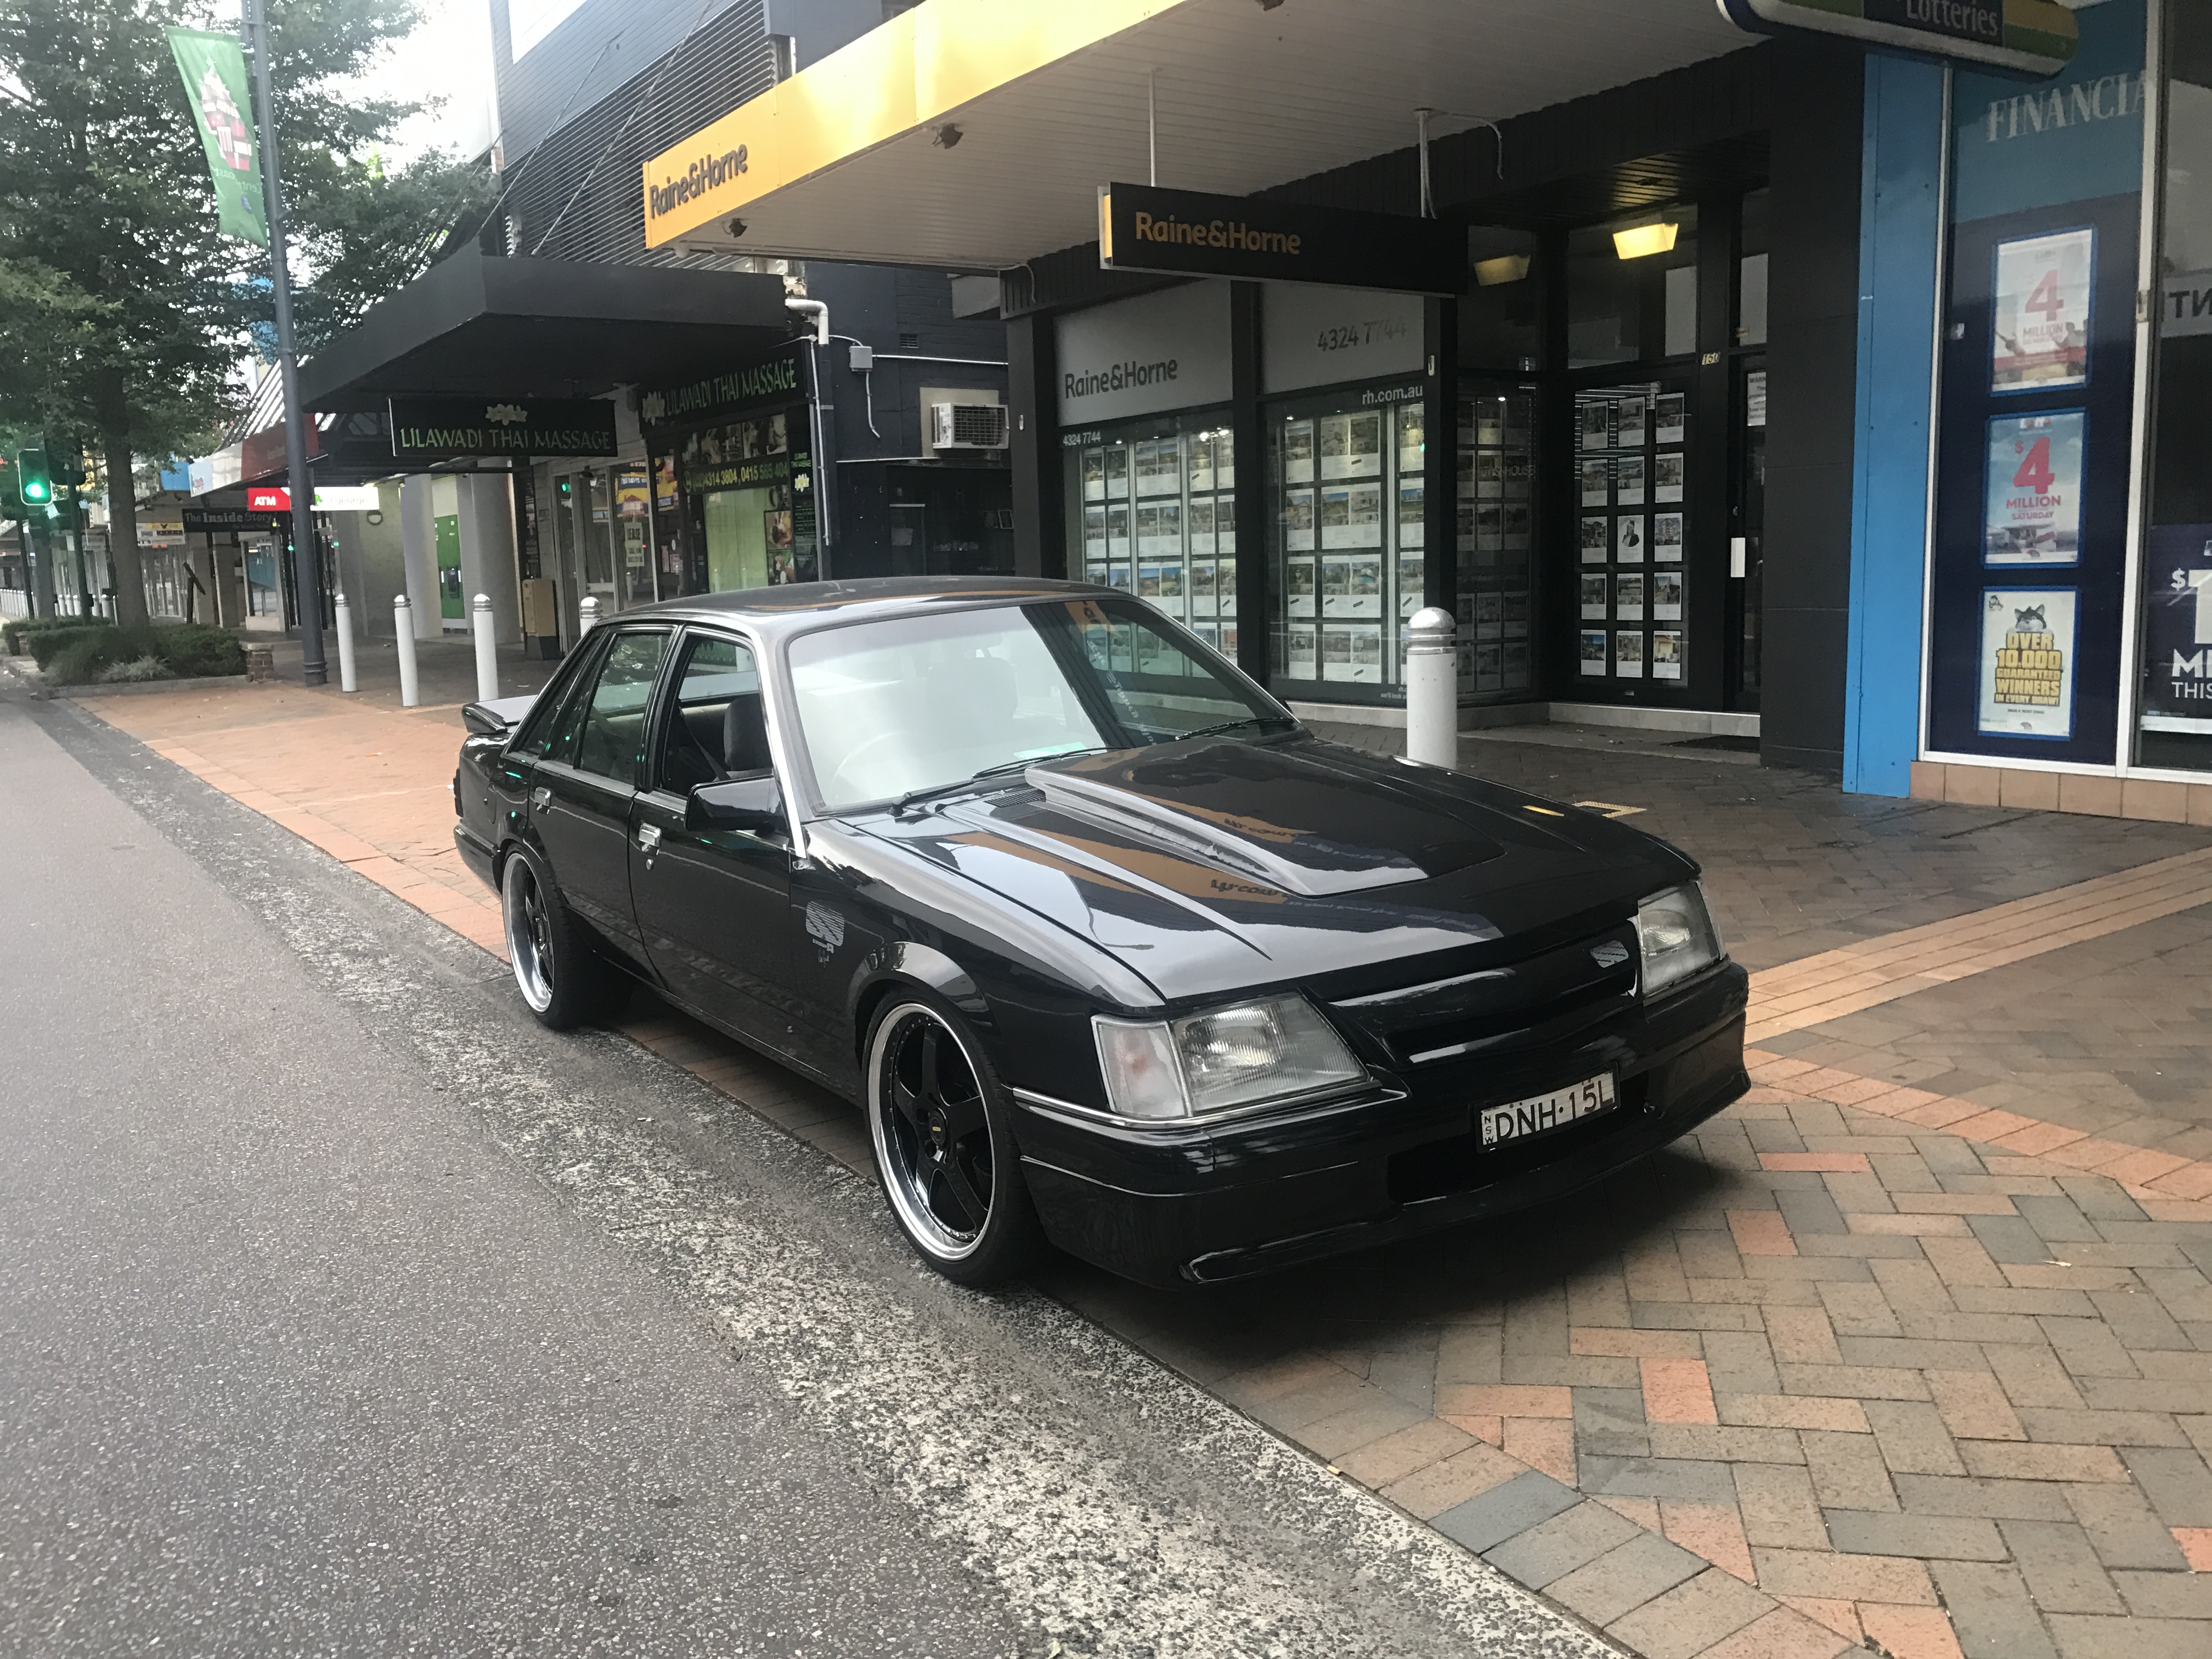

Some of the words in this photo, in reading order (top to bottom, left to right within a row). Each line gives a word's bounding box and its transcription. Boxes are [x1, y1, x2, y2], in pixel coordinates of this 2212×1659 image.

[1906, 0, 1999, 36] Lotteries
[650, 144, 748, 219] Raine&Horne
[1136, 212, 1301, 255] Raine&Horne
[1318, 325, 1359, 351] 4324
[666, 380, 712, 416] LILAWADI
[713, 371, 739, 403] THAI
[741, 358, 796, 398] MASSAGE
[1065, 359, 1178, 399] Raine&Horne
[1362, 385, 1423, 404] rh.com.au
[400, 428, 483, 448] LILAWADI
[490, 428, 529, 448] THAI
[534, 430, 611, 450] MASSAGE
[1063, 434, 1081, 446] 4324
[1083, 431, 1101, 443] 7744
[254, 496, 276, 506] ATM
[2006, 495, 2061, 509] MILLION
[185, 512, 201, 522] The
[202, 512, 243, 522] Inside
[245, 512, 272, 523] Story
[2012, 511, 2054, 520] SATURDAY
[2007, 633, 2053, 650] OVER
[1996, 679, 2061, 696] WINNERS
